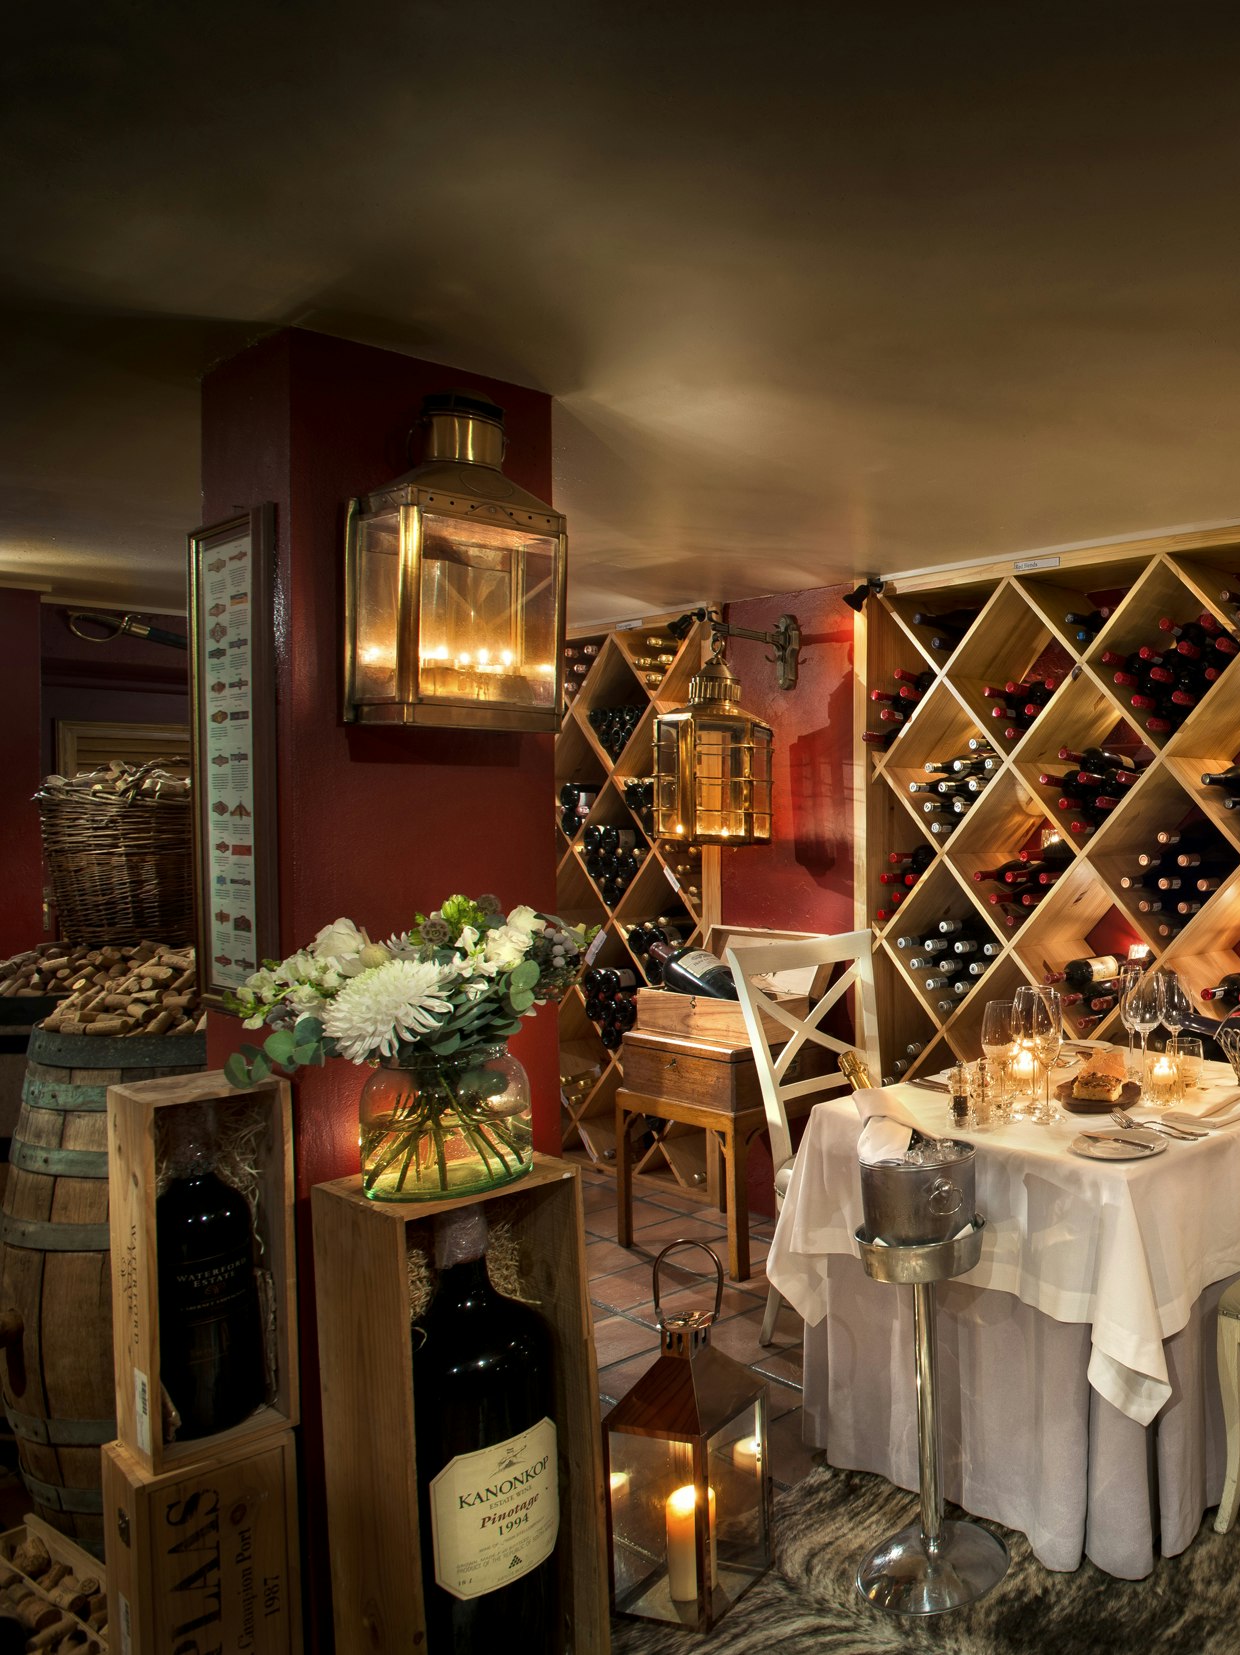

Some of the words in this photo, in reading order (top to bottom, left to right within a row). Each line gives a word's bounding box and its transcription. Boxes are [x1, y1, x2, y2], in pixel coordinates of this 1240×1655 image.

[131, 1224, 139, 1345] WATERFORD
[176, 1257, 247, 1283] WATERFORD
[193, 1271, 236, 1288] ESTATE
[458, 1455, 549, 1509] KANONKOP
[489, 1495, 514, 1510] ESTATE
[516, 1485, 533, 1498] WINE
[480, 1493, 540, 1529] Pinotage
[499, 1513, 529, 1536] 1994
[235, 1527, 253, 1565] Port
[263, 1574, 281, 1619] 1987
